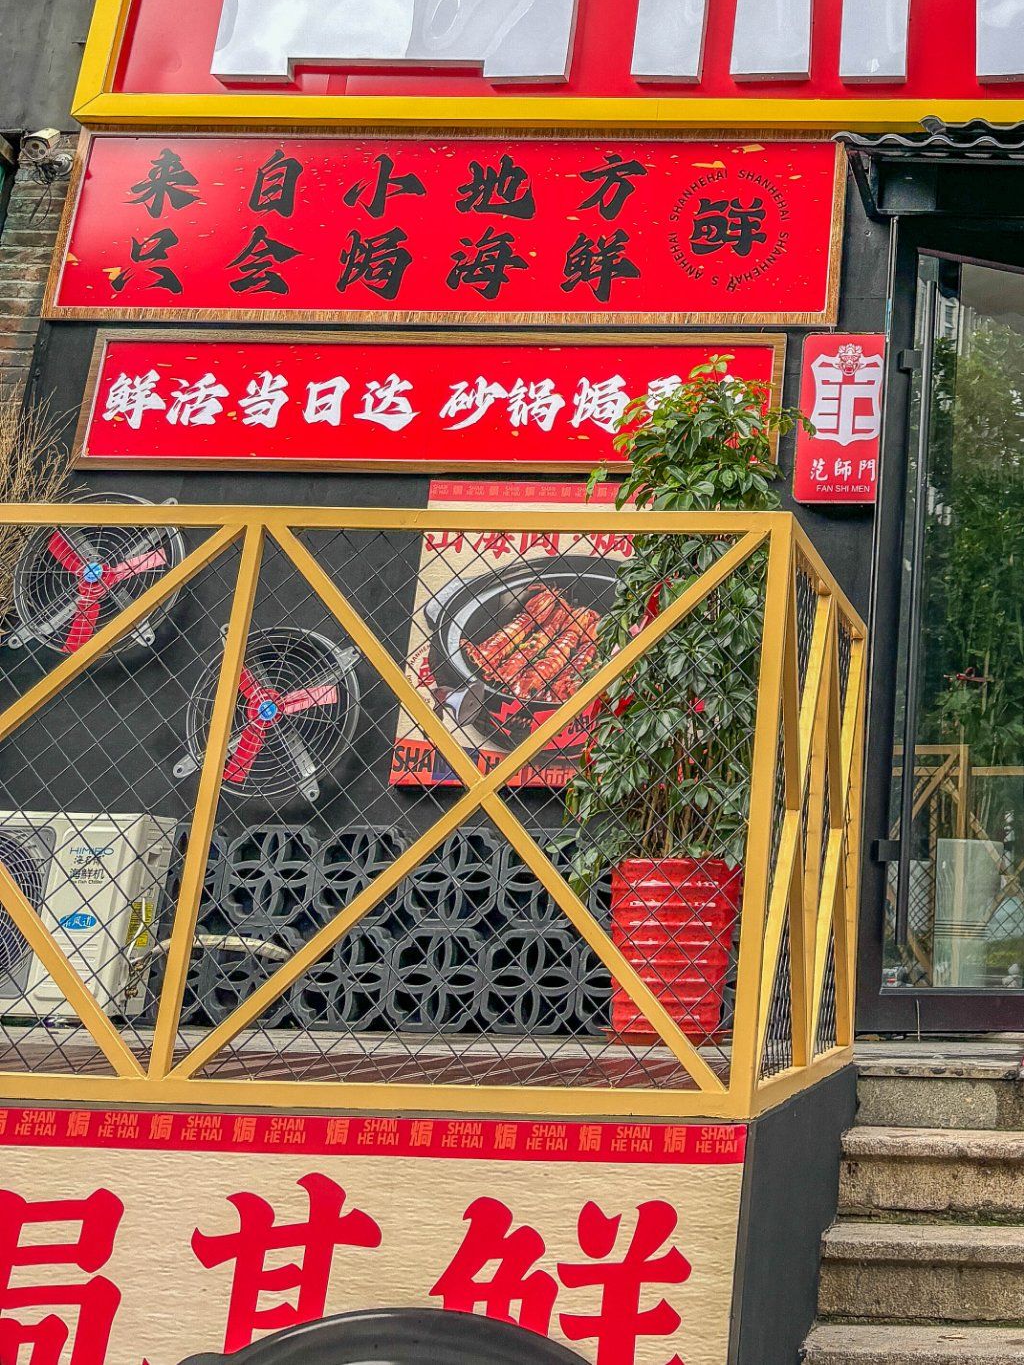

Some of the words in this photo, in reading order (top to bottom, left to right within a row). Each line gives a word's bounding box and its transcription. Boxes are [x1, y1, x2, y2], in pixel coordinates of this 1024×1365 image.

[124, 148, 647, 219] 来自小地方
[670, 170, 727, 221] SHANHEHAI
[738, 170, 791, 221] SHANHEHAI
[689, 197, 767, 256] 鲜
[109, 227, 642, 302] 只会焗海鲜
[102, 371, 421, 432] 鲜活当日达
[21, 1111, 56, 1123] SHAN
[104, 1114, 139, 1126] SHAN
[15, 1123, 31, 1135] HE
[34, 1124, 56, 1136] HAI
[66, 1111, 91, 1137] 焗
[148, 1114, 173, 1140] 焗
[270, 1119, 305, 1131] SHAN
[363, 1120, 398, 1133] SHAN
[447, 1122, 482, 1135] SHAN
[98, 1126, 114, 1138] HE
[117, 1126, 139, 1138] HAI
[264, 1131, 280, 1143] HE
[284, 1131, 305, 1143] HAI
[325, 1120, 349, 1145] 焗
[409, 1121, 433, 1147] 焗
[494, 1124, 518, 1150] 焗
[616, 1126, 651, 1139] SHAN
[700, 1127, 735, 1140] SHAN
[357, 1132, 373, 1145] HE
[377, 1133, 399, 1146] HAI
[441, 1135, 458, 1147] HE
[461, 1135, 483, 1148] HAI
[610, 1139, 627, 1152] HE
[630, 1139, 652, 1152] HAI
[662, 1127, 686, 1153] 焗
[695, 1140, 712, 1152] HE
[715, 1140, 738, 1153] HAI
